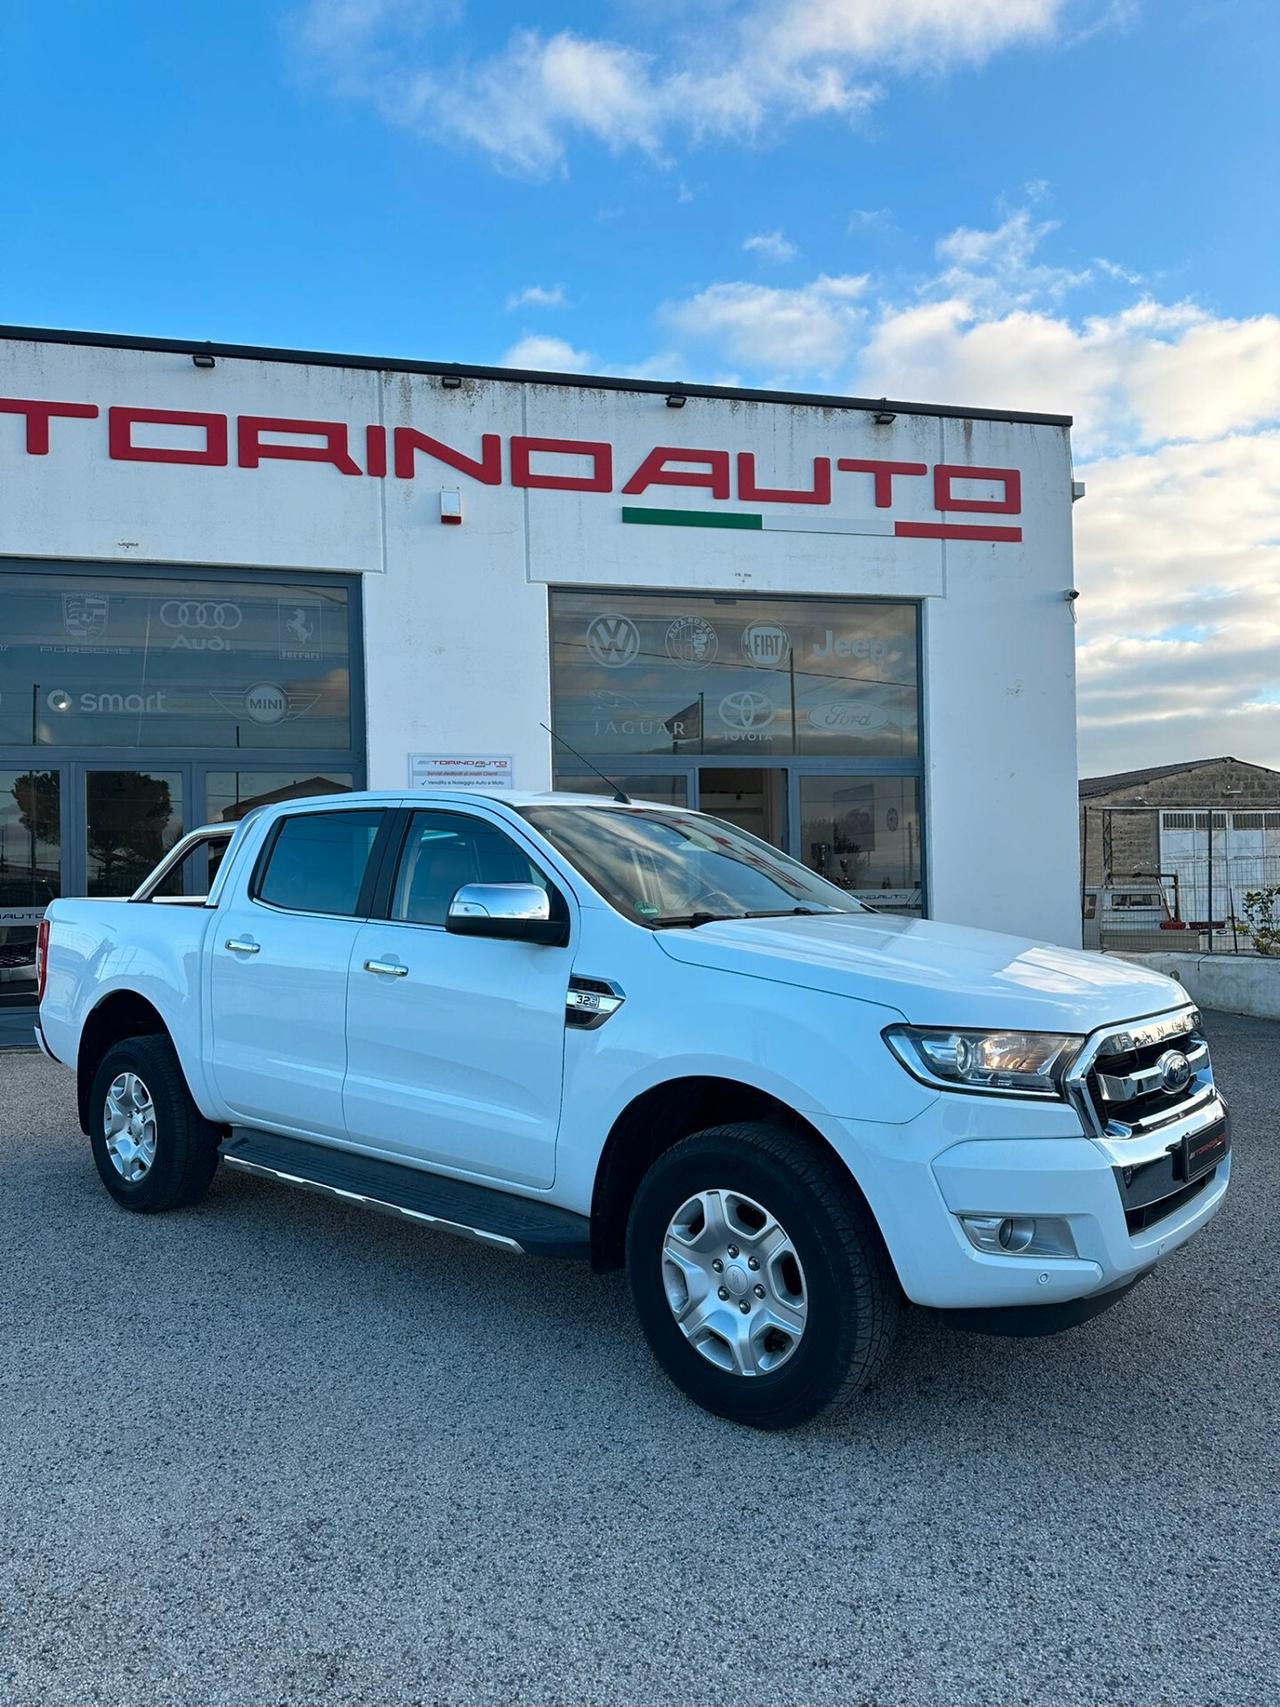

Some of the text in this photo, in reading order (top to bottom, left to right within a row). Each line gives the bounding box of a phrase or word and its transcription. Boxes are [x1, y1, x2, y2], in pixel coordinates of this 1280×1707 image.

[0, 398, 1023, 515] TORINOAUTO
[668, 617, 715, 639] ALFA ROMEO
[39, 645, 131, 655] PORSCHE
[171, 634, 231, 651] Audi
[753, 634, 781, 656] FIAT
[812, 629, 888, 663] Jeep
[80, 690, 167, 713] smart
[249, 699, 282, 710] MINI
[825, 704, 873, 726] Ford
[594, 720, 685, 736] JAGUAR
[724, 731, 773, 741] TOYOTA
[0, 912, 45, 920] AUTO
